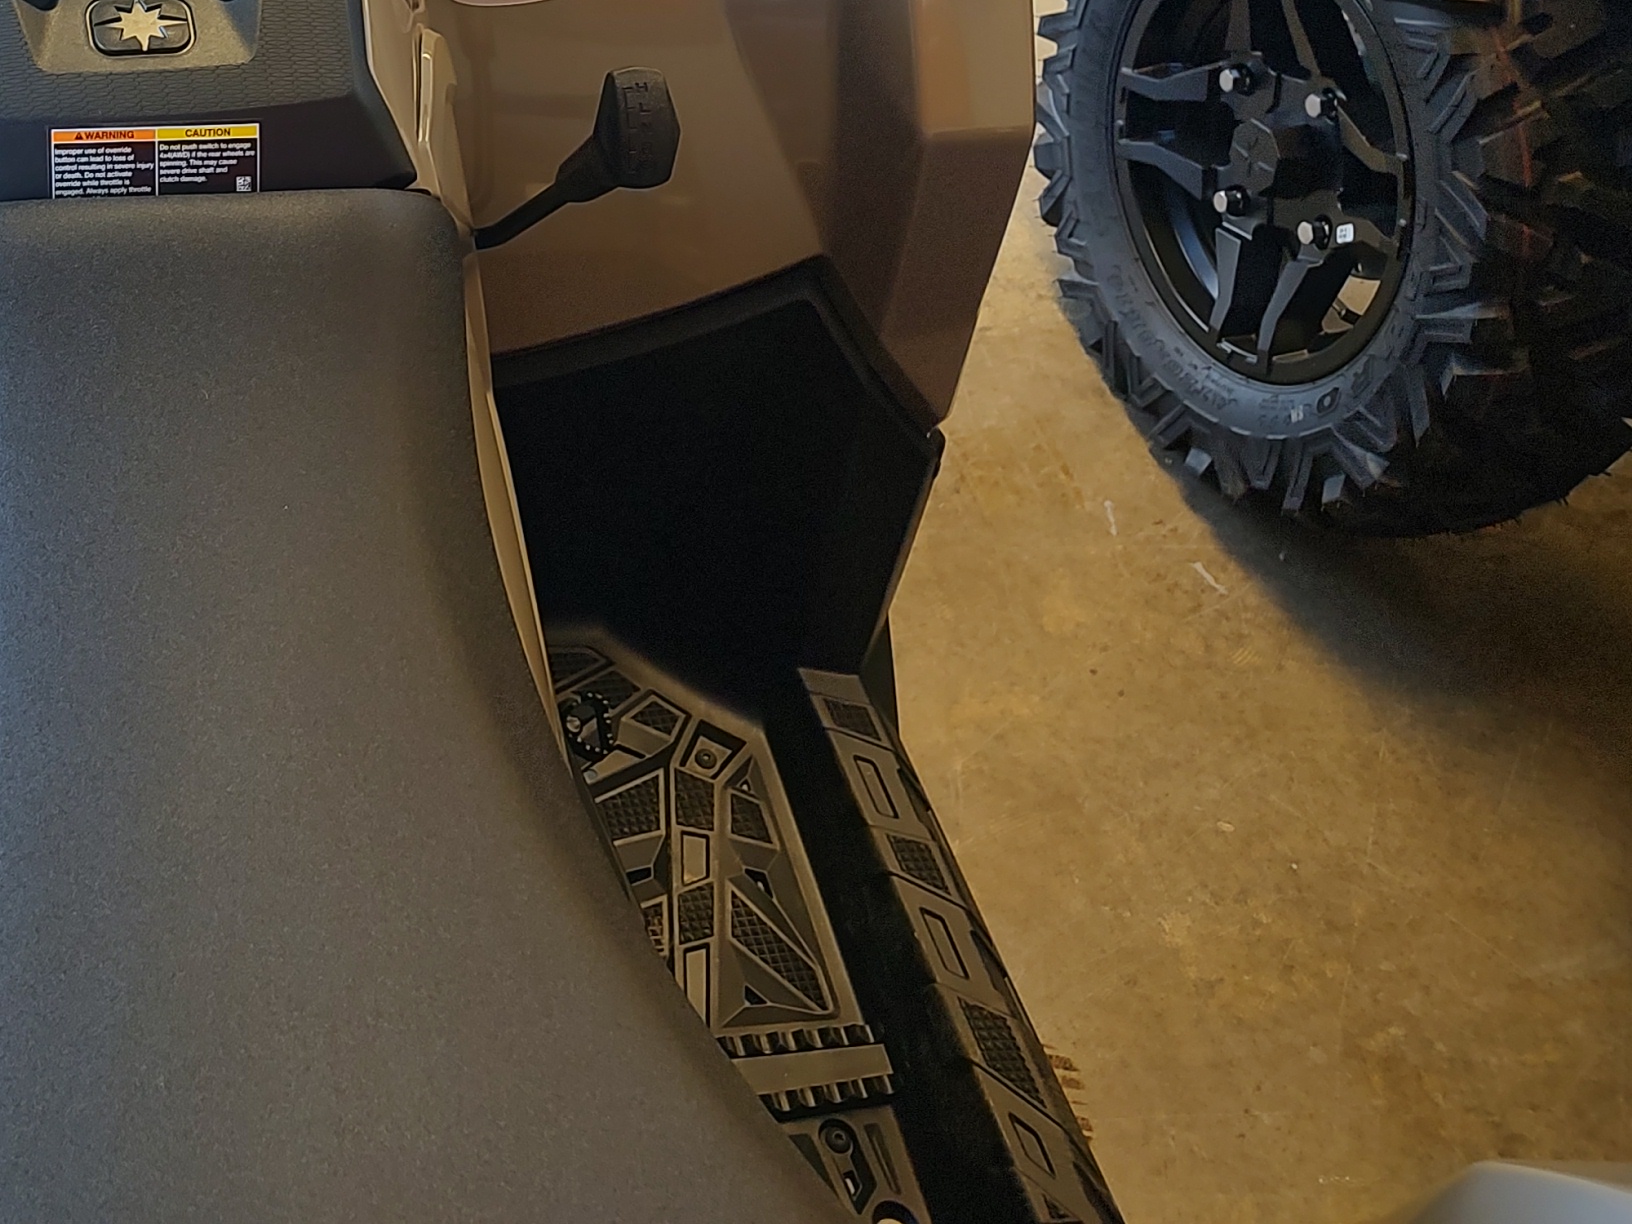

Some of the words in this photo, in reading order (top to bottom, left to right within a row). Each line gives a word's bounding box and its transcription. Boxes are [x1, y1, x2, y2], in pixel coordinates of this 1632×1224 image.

[86, 131, 134, 140] WARNING
[185, 128, 230, 137] CAUTION
[182, 143, 197, 152] push
[137, 162, 154, 170] injury
[55, 188, 84, 196] engaged.
